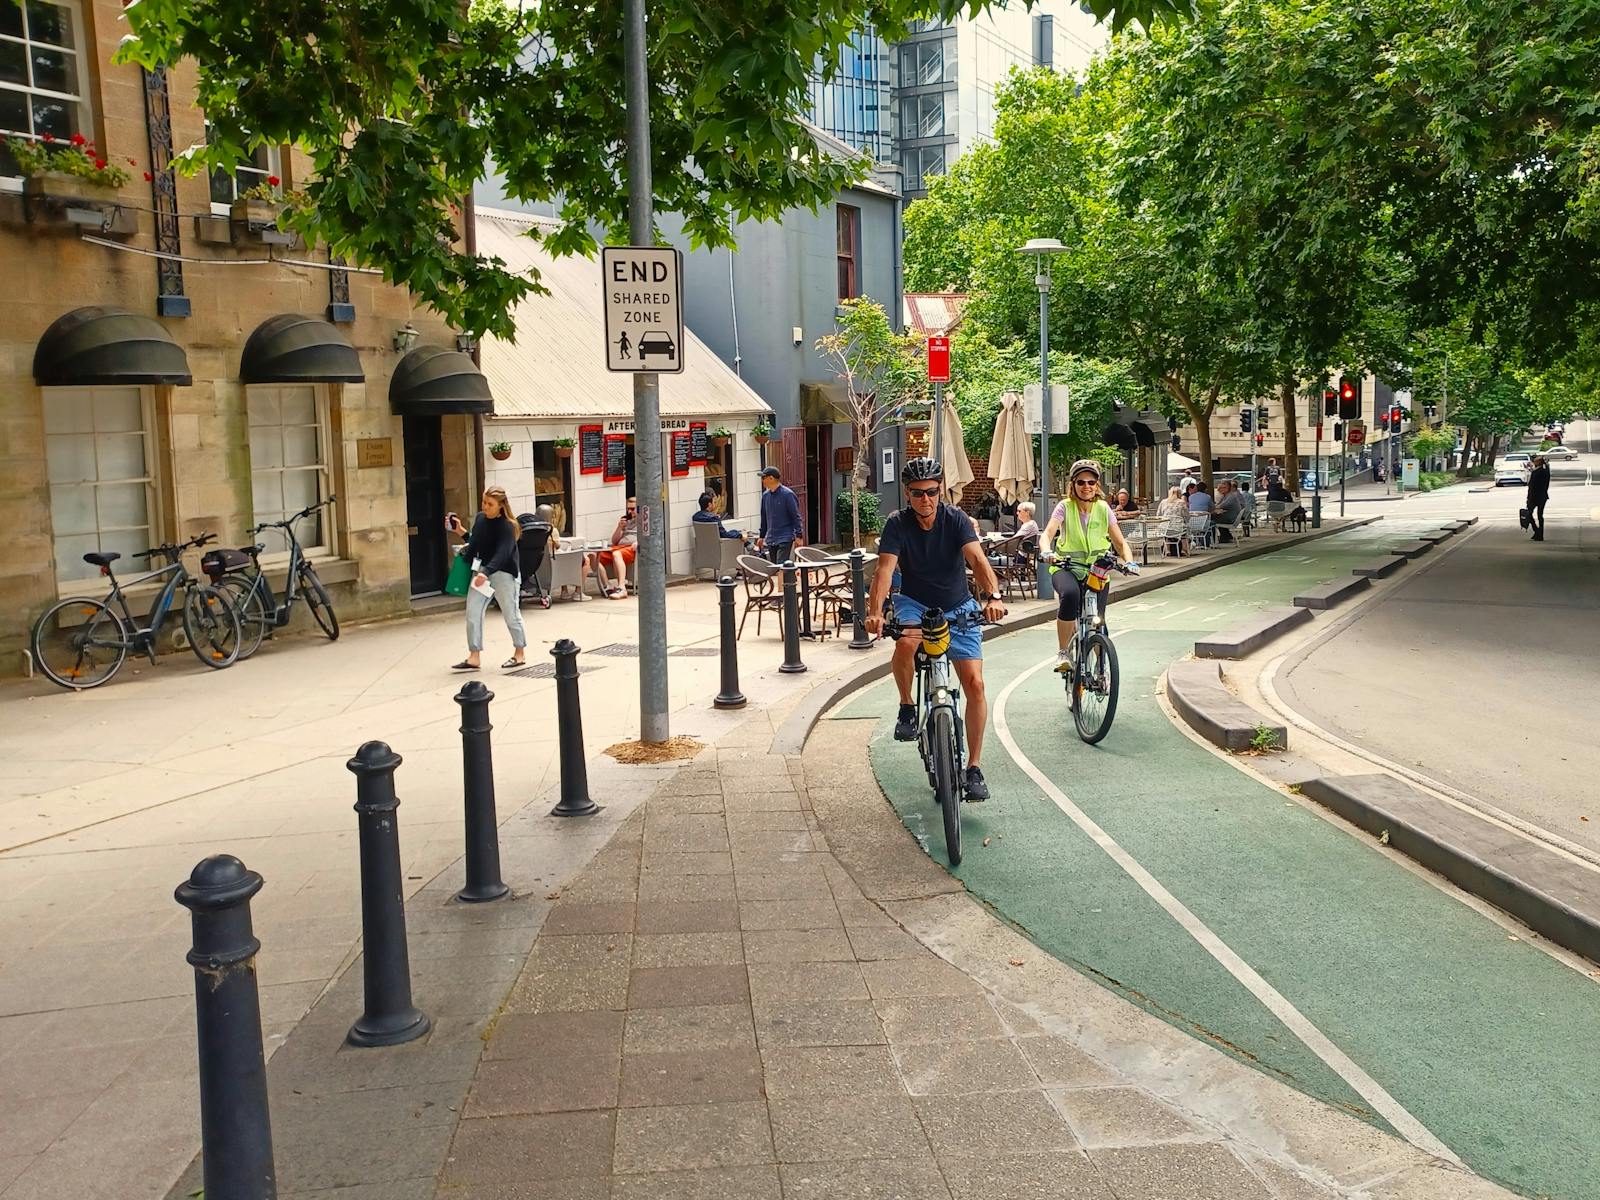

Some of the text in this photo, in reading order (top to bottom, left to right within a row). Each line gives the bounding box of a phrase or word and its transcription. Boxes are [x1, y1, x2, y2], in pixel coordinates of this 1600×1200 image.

[613, 261, 668, 282] END
[613, 292, 670, 304] SHARED
[624, 311, 661, 323] ZONE
[661, 420, 686, 429] BREAD
